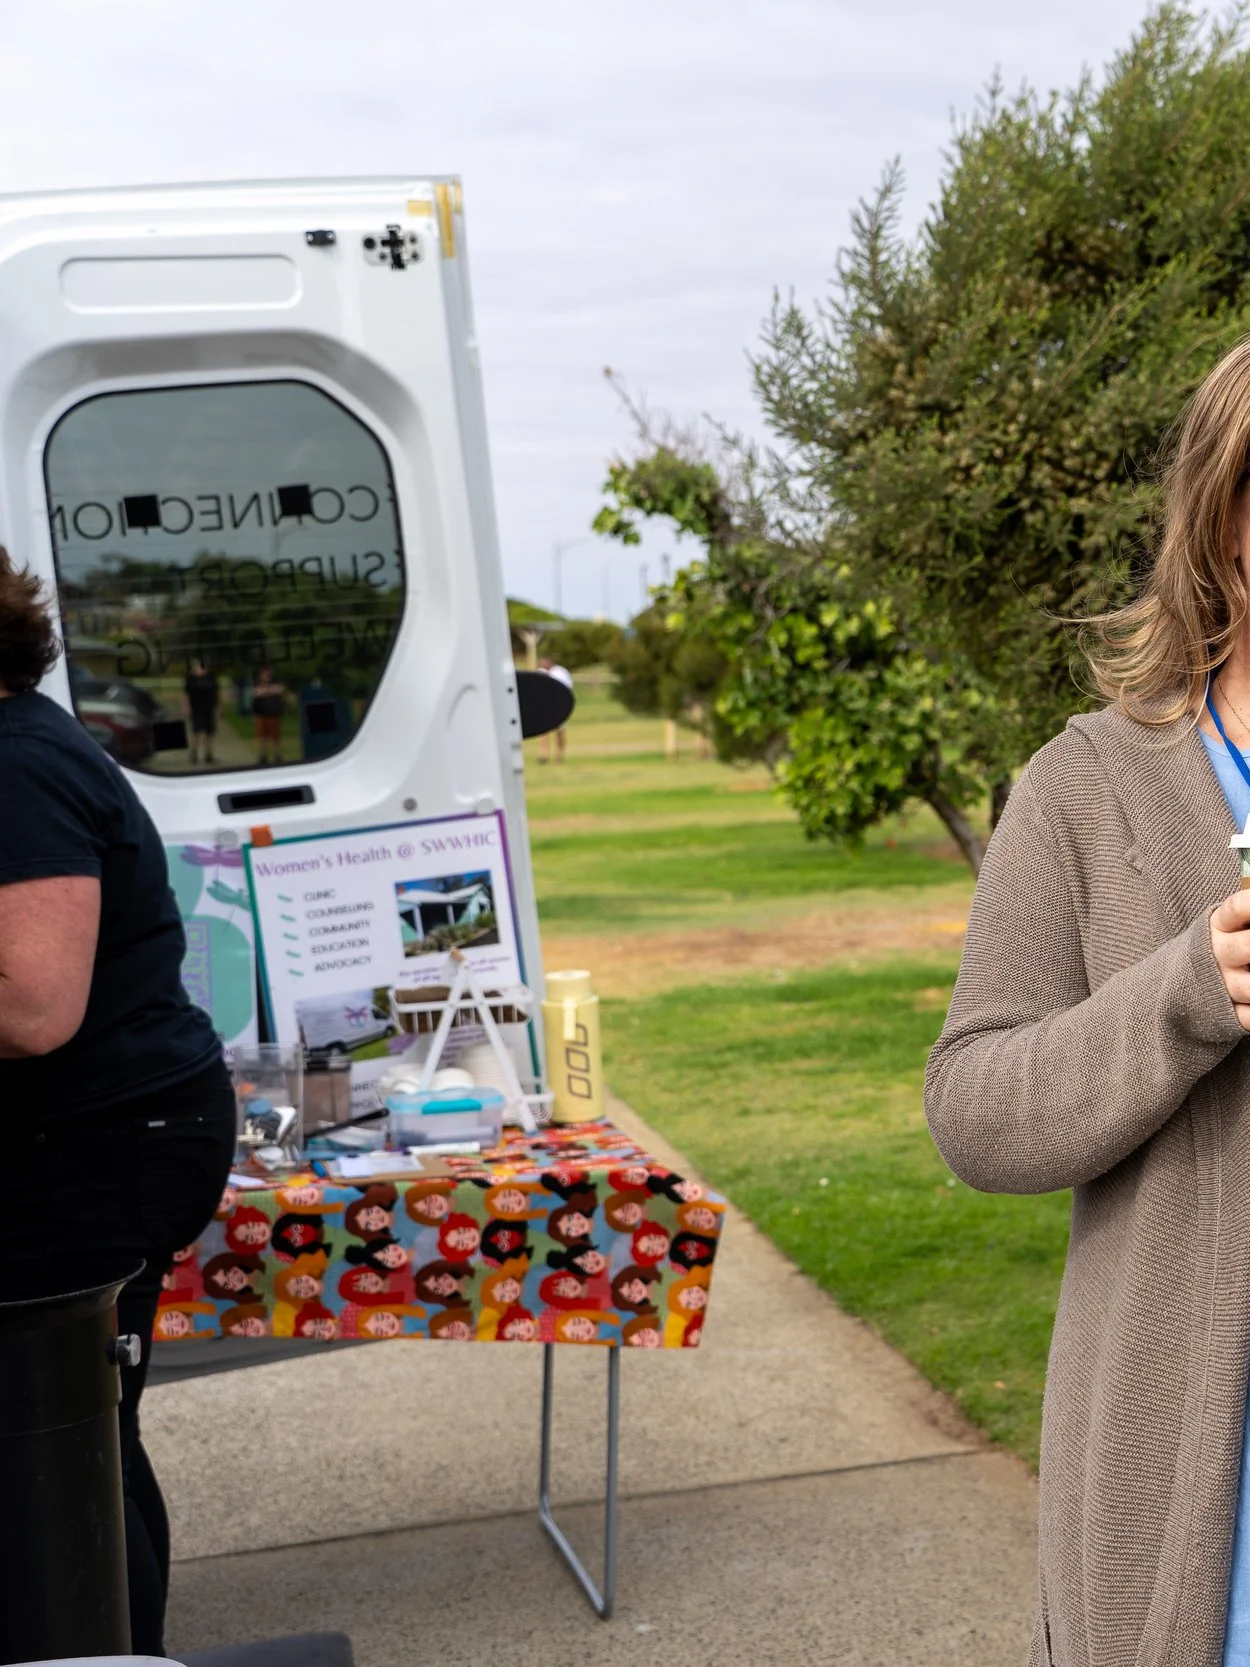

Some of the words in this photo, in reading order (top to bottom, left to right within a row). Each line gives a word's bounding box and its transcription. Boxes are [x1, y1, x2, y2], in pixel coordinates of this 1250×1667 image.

[256, 853, 334, 878] Women's
[337, 844, 392, 867] Health
[396, 841, 416, 860] @
[421, 830, 498, 856] SWWHIC
[303, 888, 337, 902] CLINIC
[305, 901, 375, 920] COUNSELLING
[308, 919, 372, 938] COMMUNITY
[311, 937, 370, 956] EDUCATION
[314, 954, 373, 973] ADVOCACY
